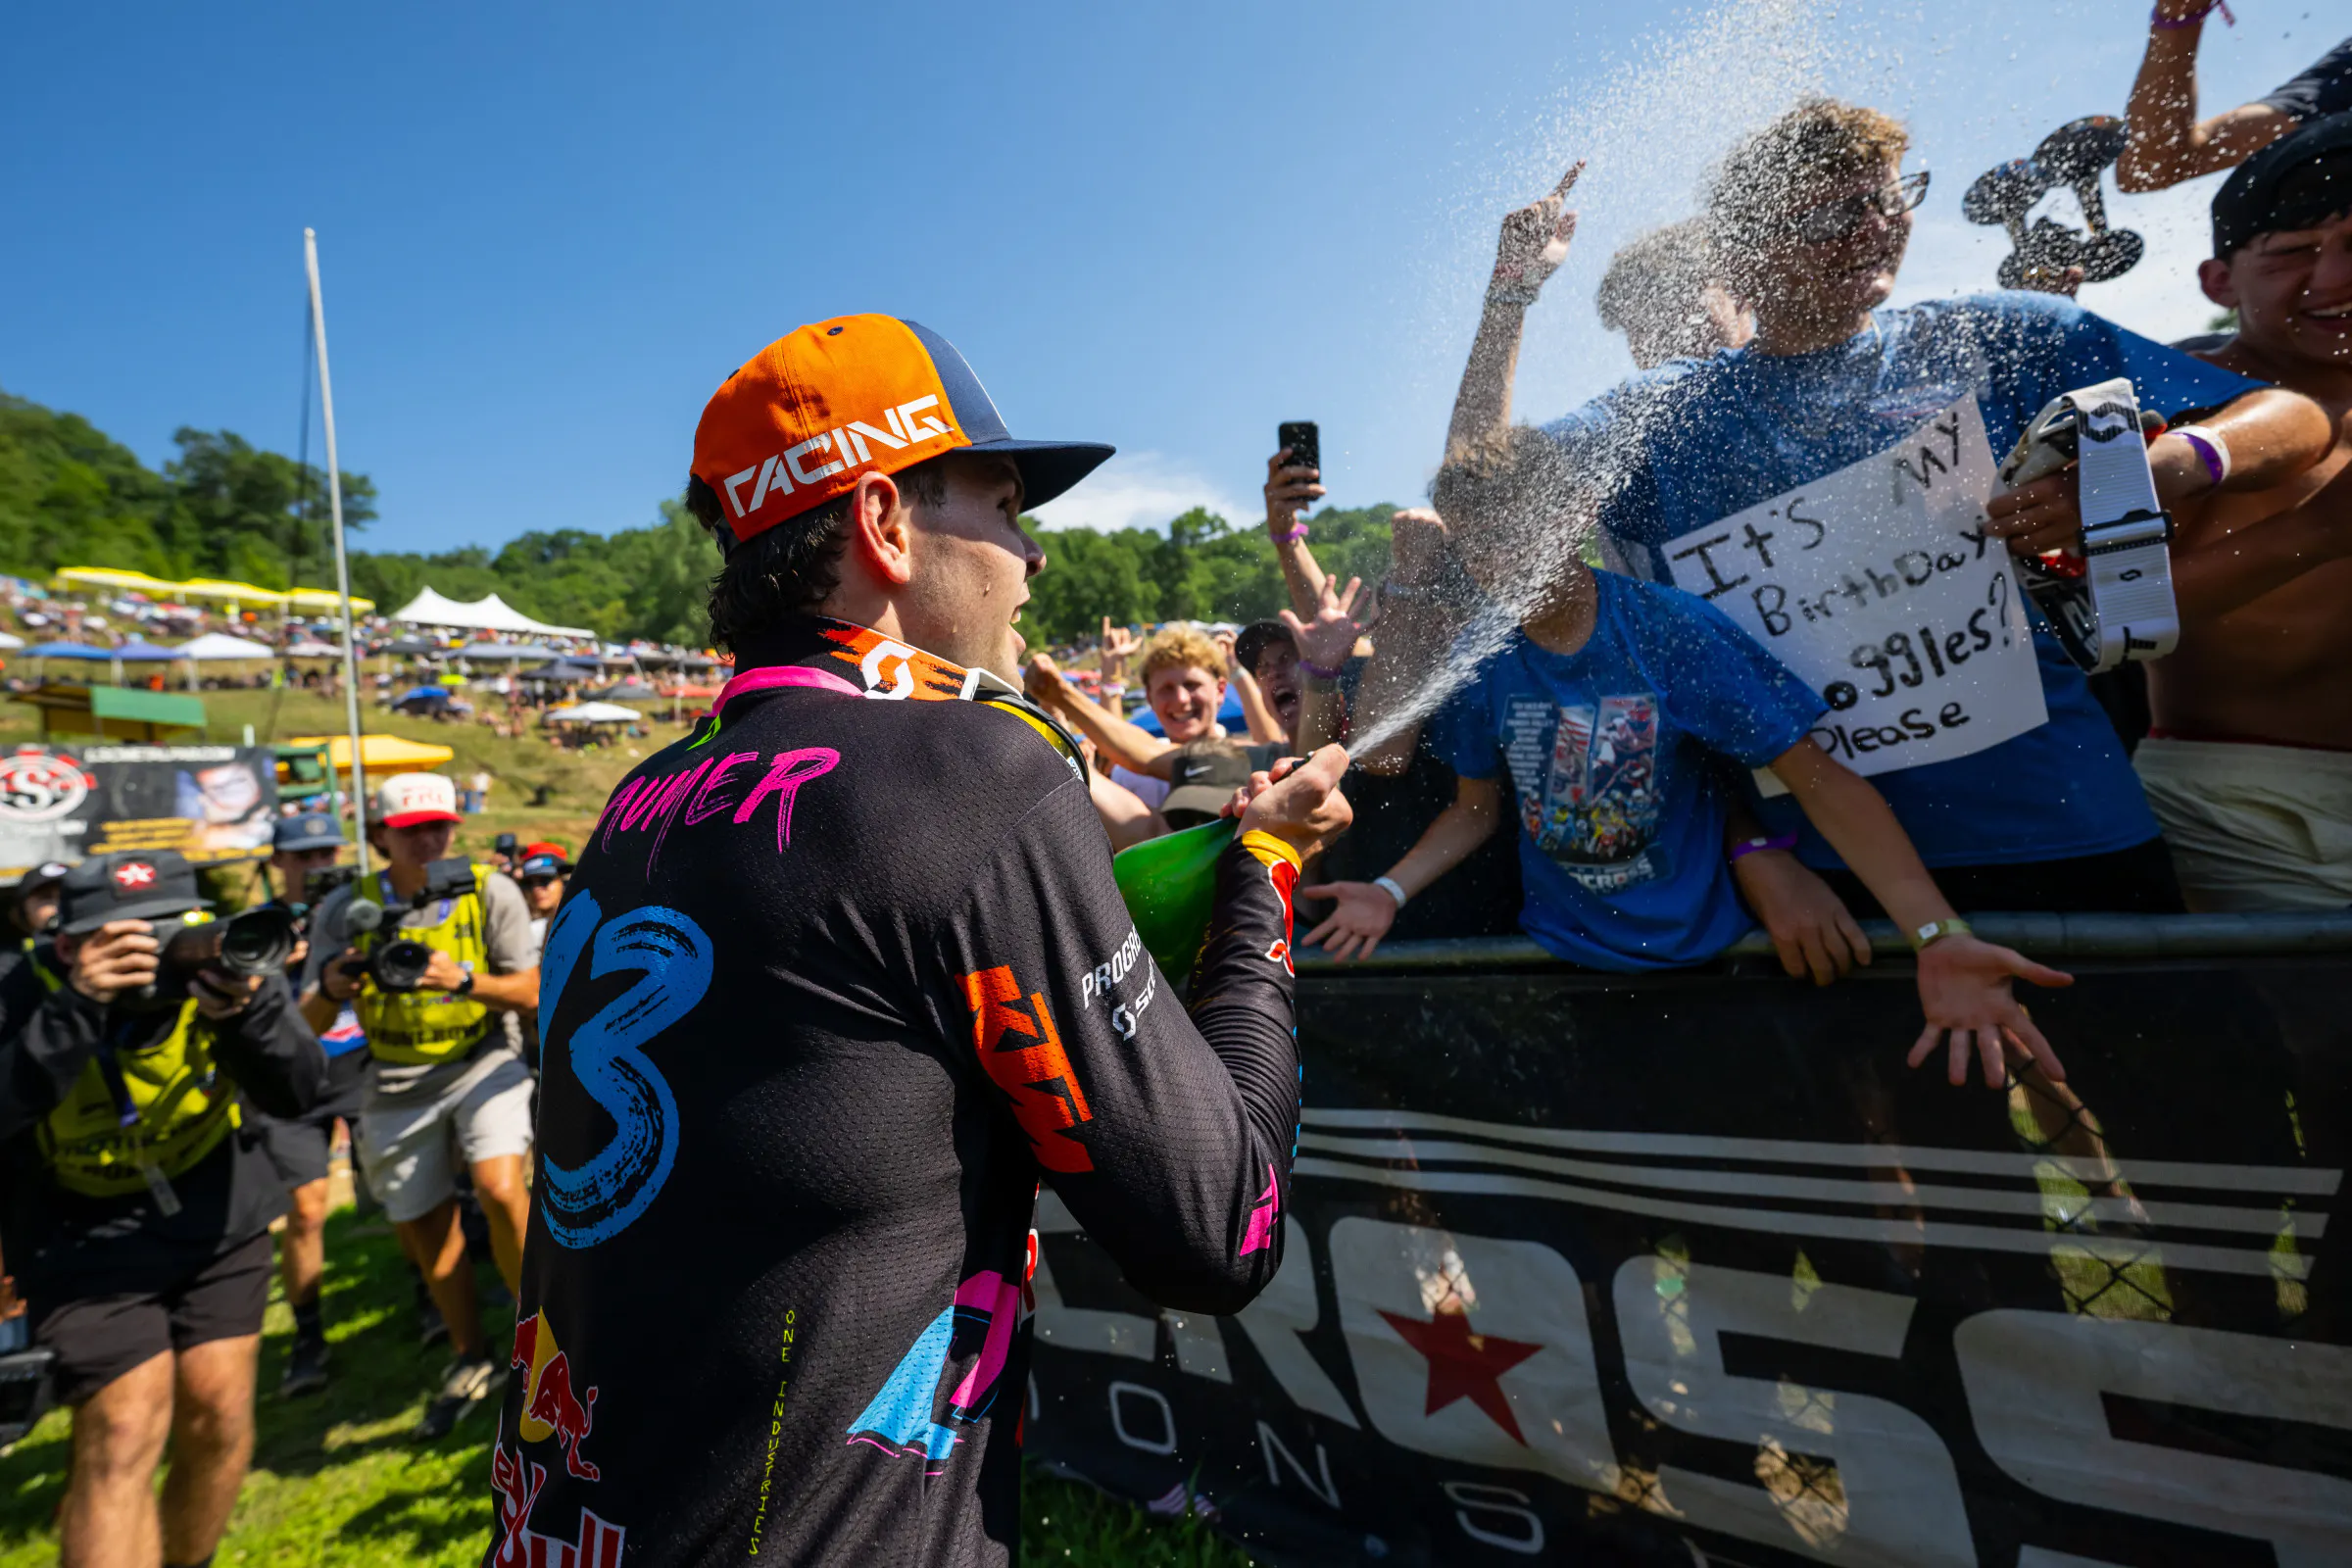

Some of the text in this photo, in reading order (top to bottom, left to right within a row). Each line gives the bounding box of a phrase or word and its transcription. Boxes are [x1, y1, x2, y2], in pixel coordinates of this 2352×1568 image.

[1824, 571, 2009, 710] oggles?
[954, 964, 1096, 1174] KTM
[748, 1309, 796, 1556] ONE INDUSTRIES
